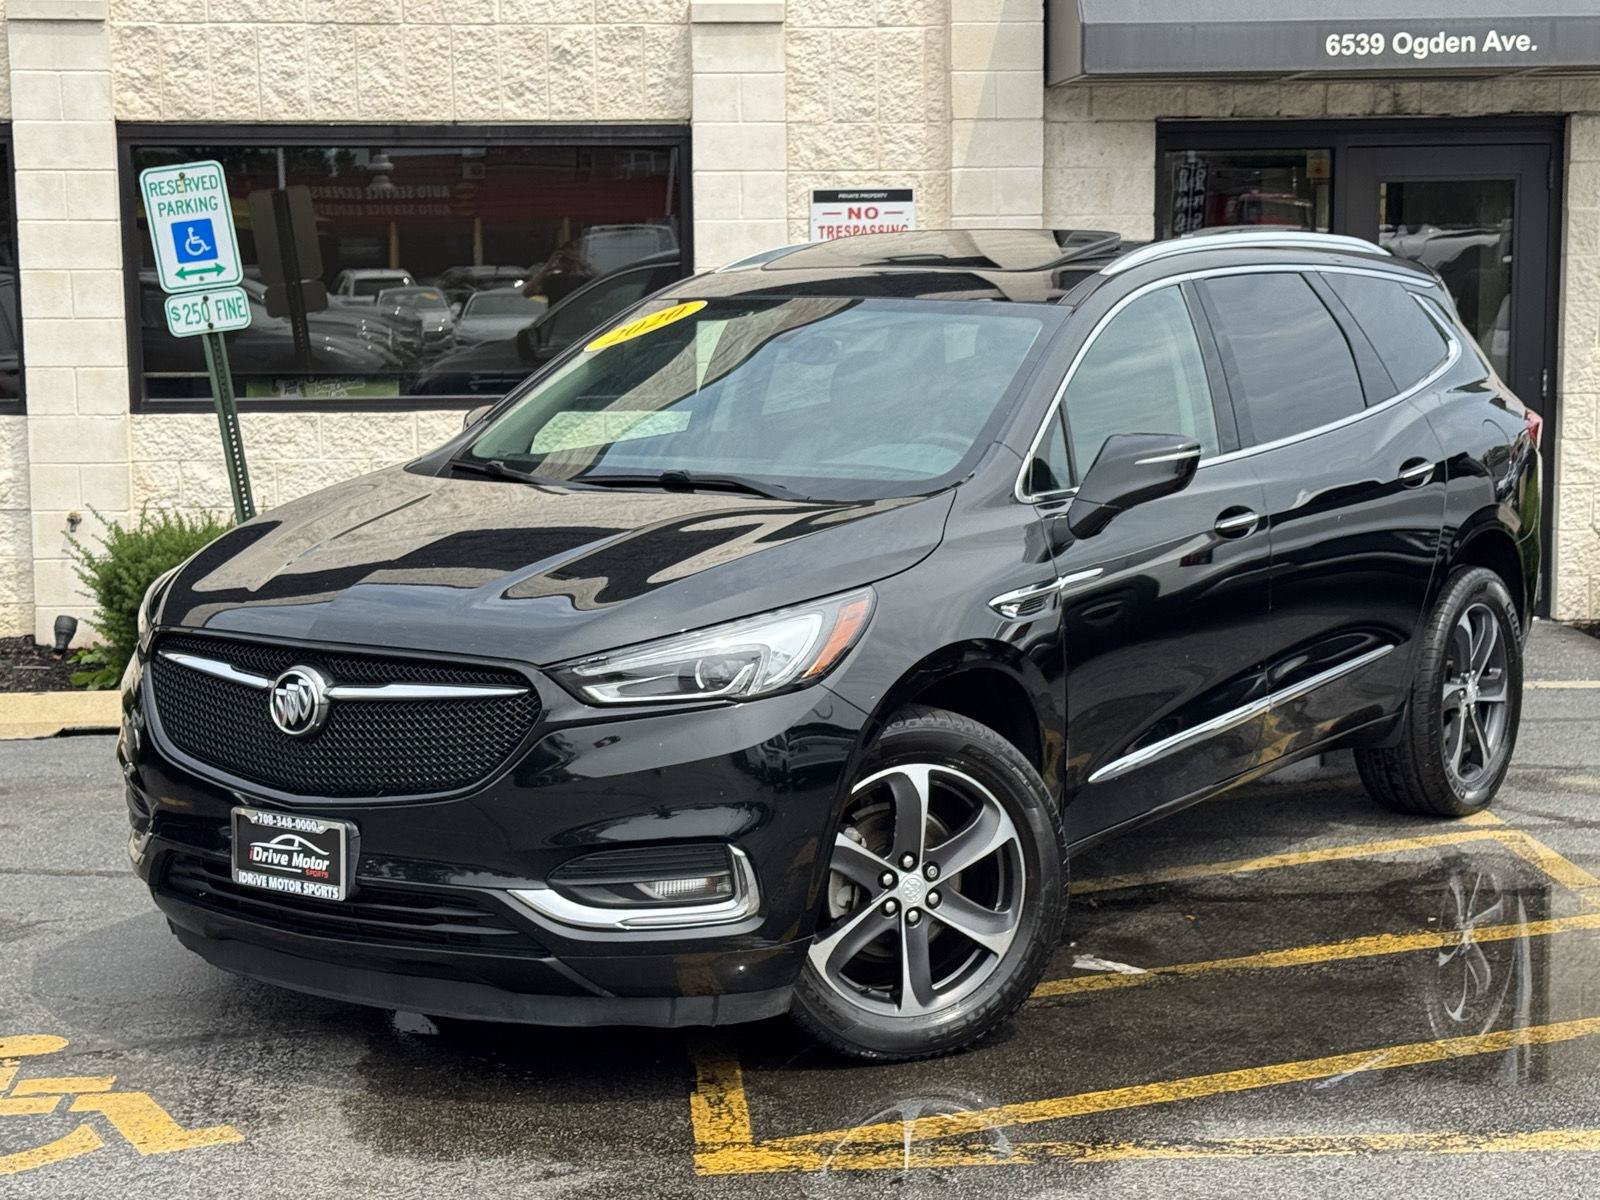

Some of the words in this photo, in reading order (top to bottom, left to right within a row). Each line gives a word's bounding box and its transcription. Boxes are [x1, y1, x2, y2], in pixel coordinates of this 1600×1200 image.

[1325, 32, 1385, 56] 6539
[1392, 31, 1476, 59] Ogden
[1482, 30, 1538, 52] Ave.
[149, 174, 219, 198] RESERVED
[157, 196, 218, 217] PARKING
[847, 207, 879, 220] NO
[170, 301, 210, 326] $250
[215, 297, 246, 321] FINE
[257, 813, 317, 832] 708-348-0000
[249, 847, 289, 865] iDrive
[292, 851, 330, 871] Motor
[268, 876, 302, 893] MOTOR
[303, 882, 339, 899] SPORTS
